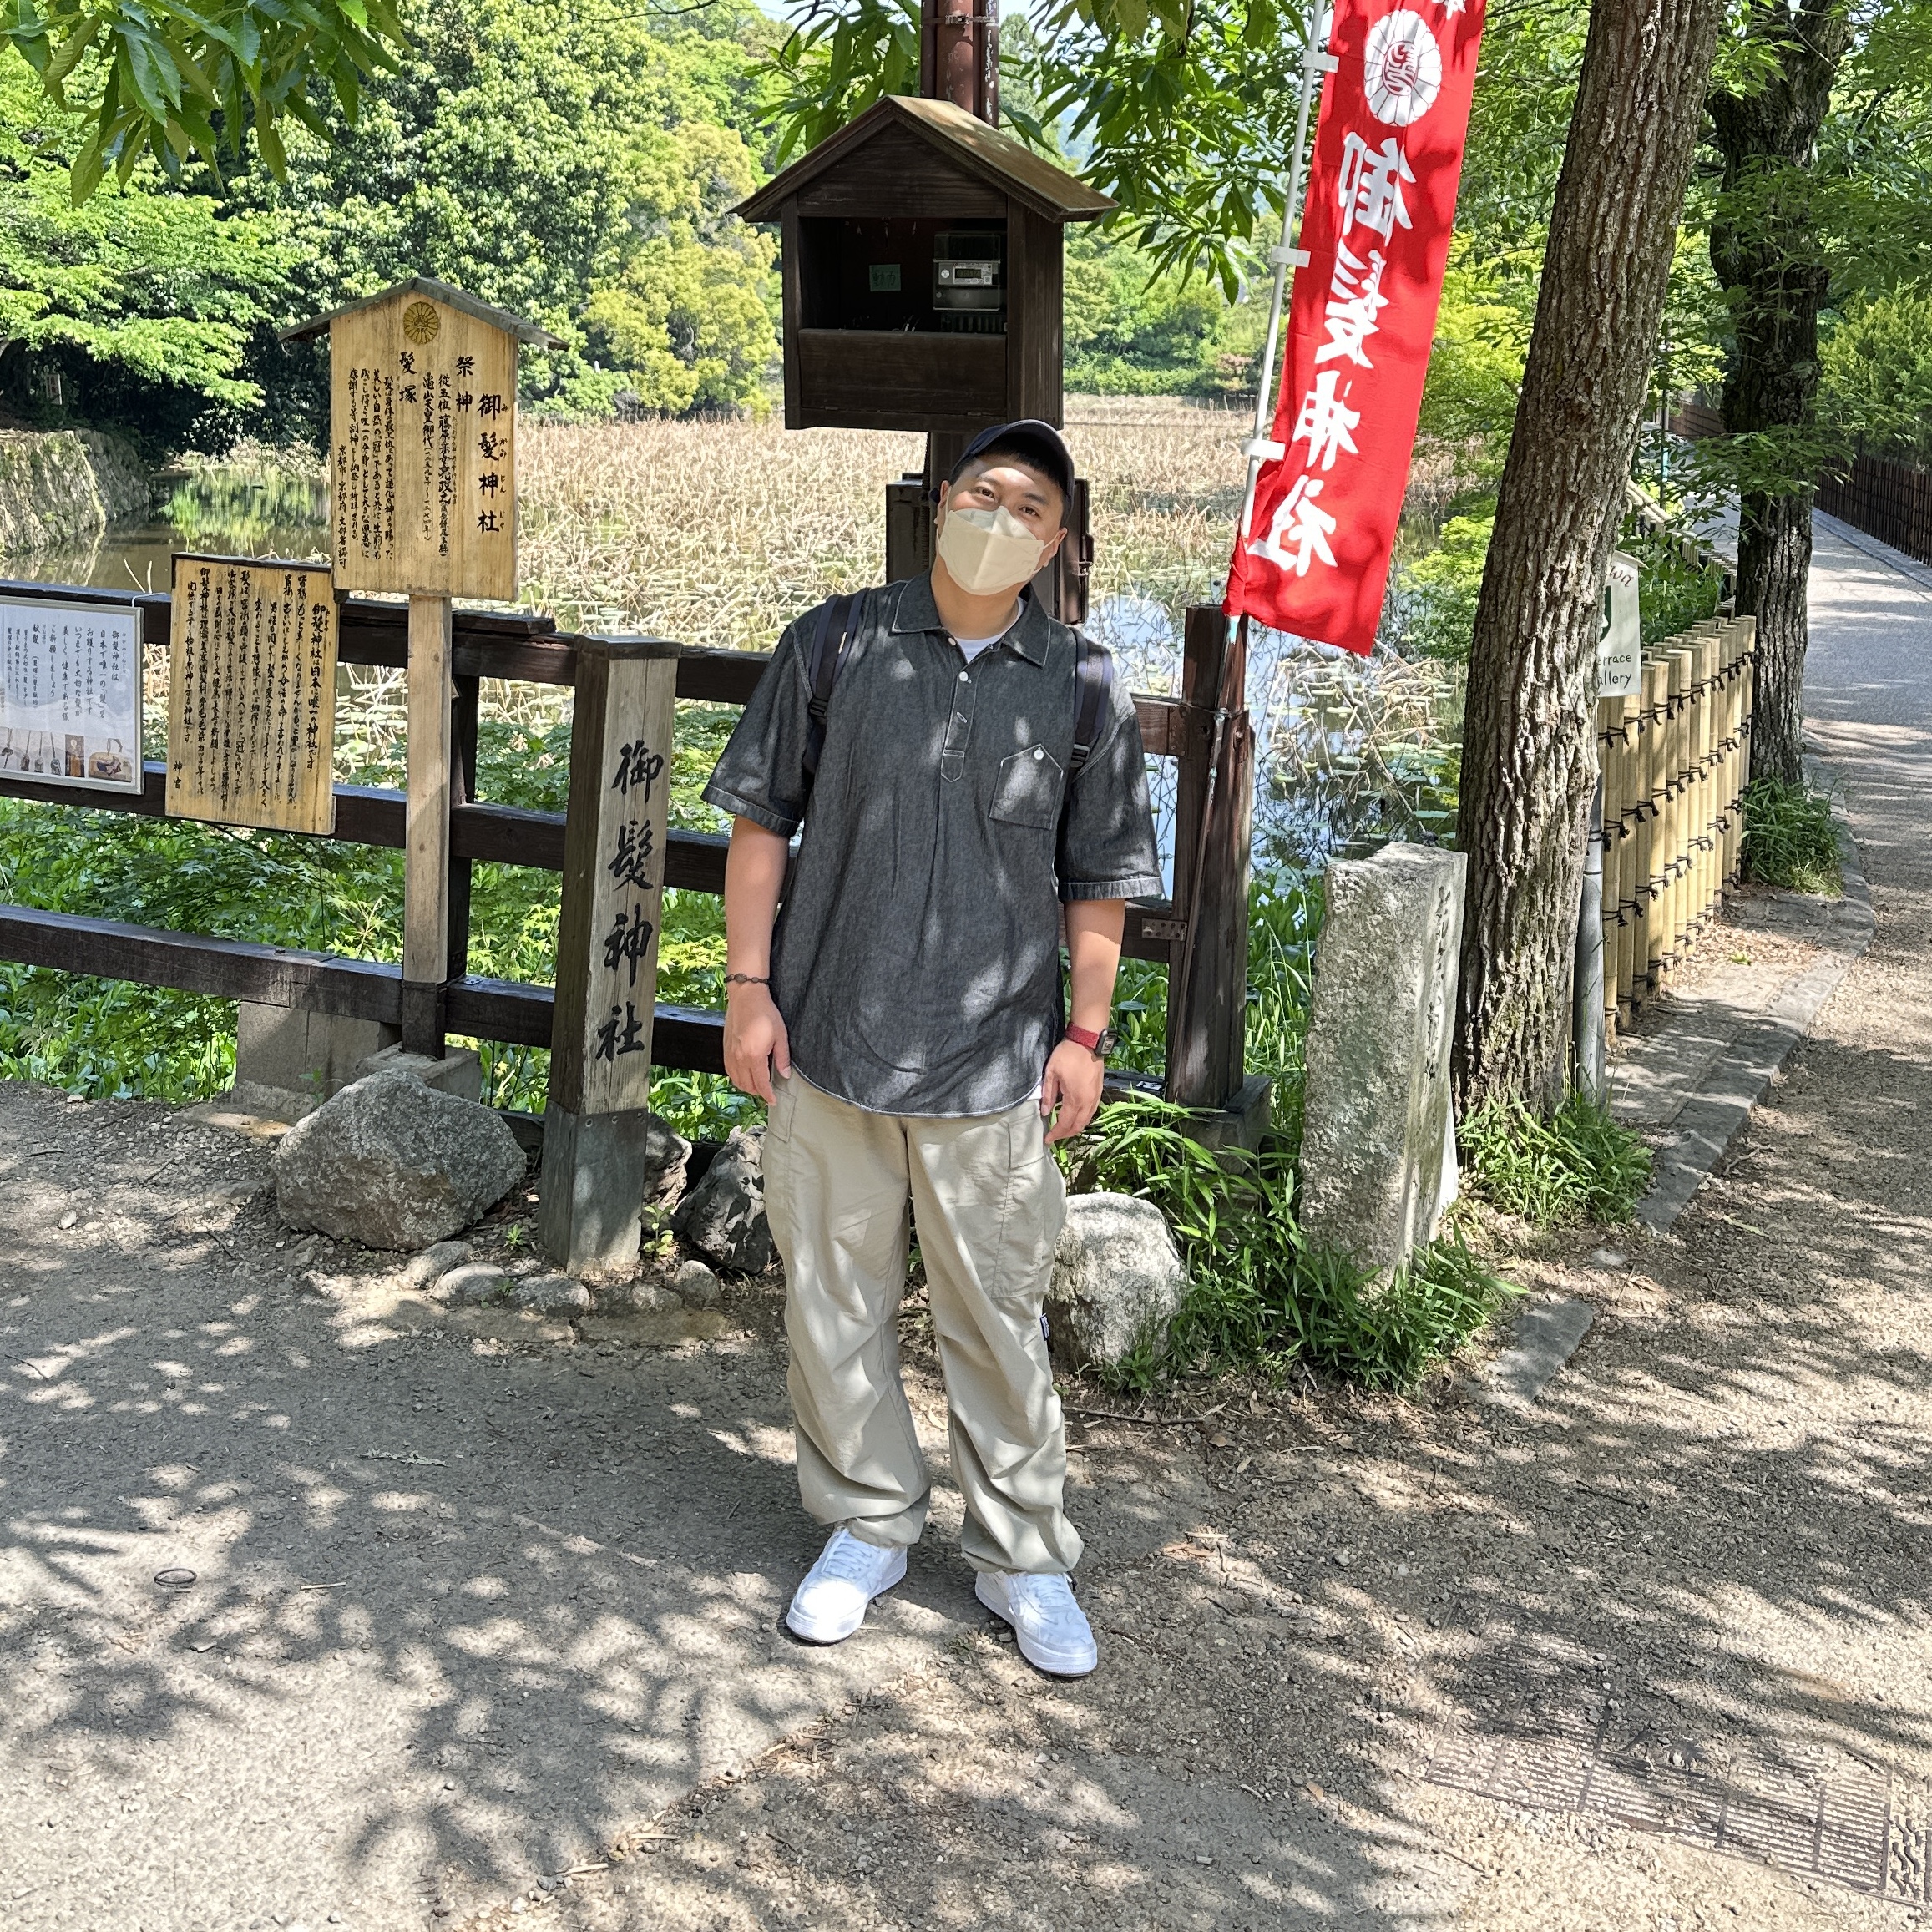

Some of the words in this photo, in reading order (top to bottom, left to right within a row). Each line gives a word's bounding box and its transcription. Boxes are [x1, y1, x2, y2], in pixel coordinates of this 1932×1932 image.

[398, 350, 417, 403] 髪塚
[455, 355, 476, 413] 祭神
[477, 393, 501, 534] 御髪神社
[111, 630, 120, 682] 御髪神社は
[1597, 654, 1632, 666] errace
[1598, 670, 1632, 689] allery
[594, 739, 665, 1063] 御髪神社
